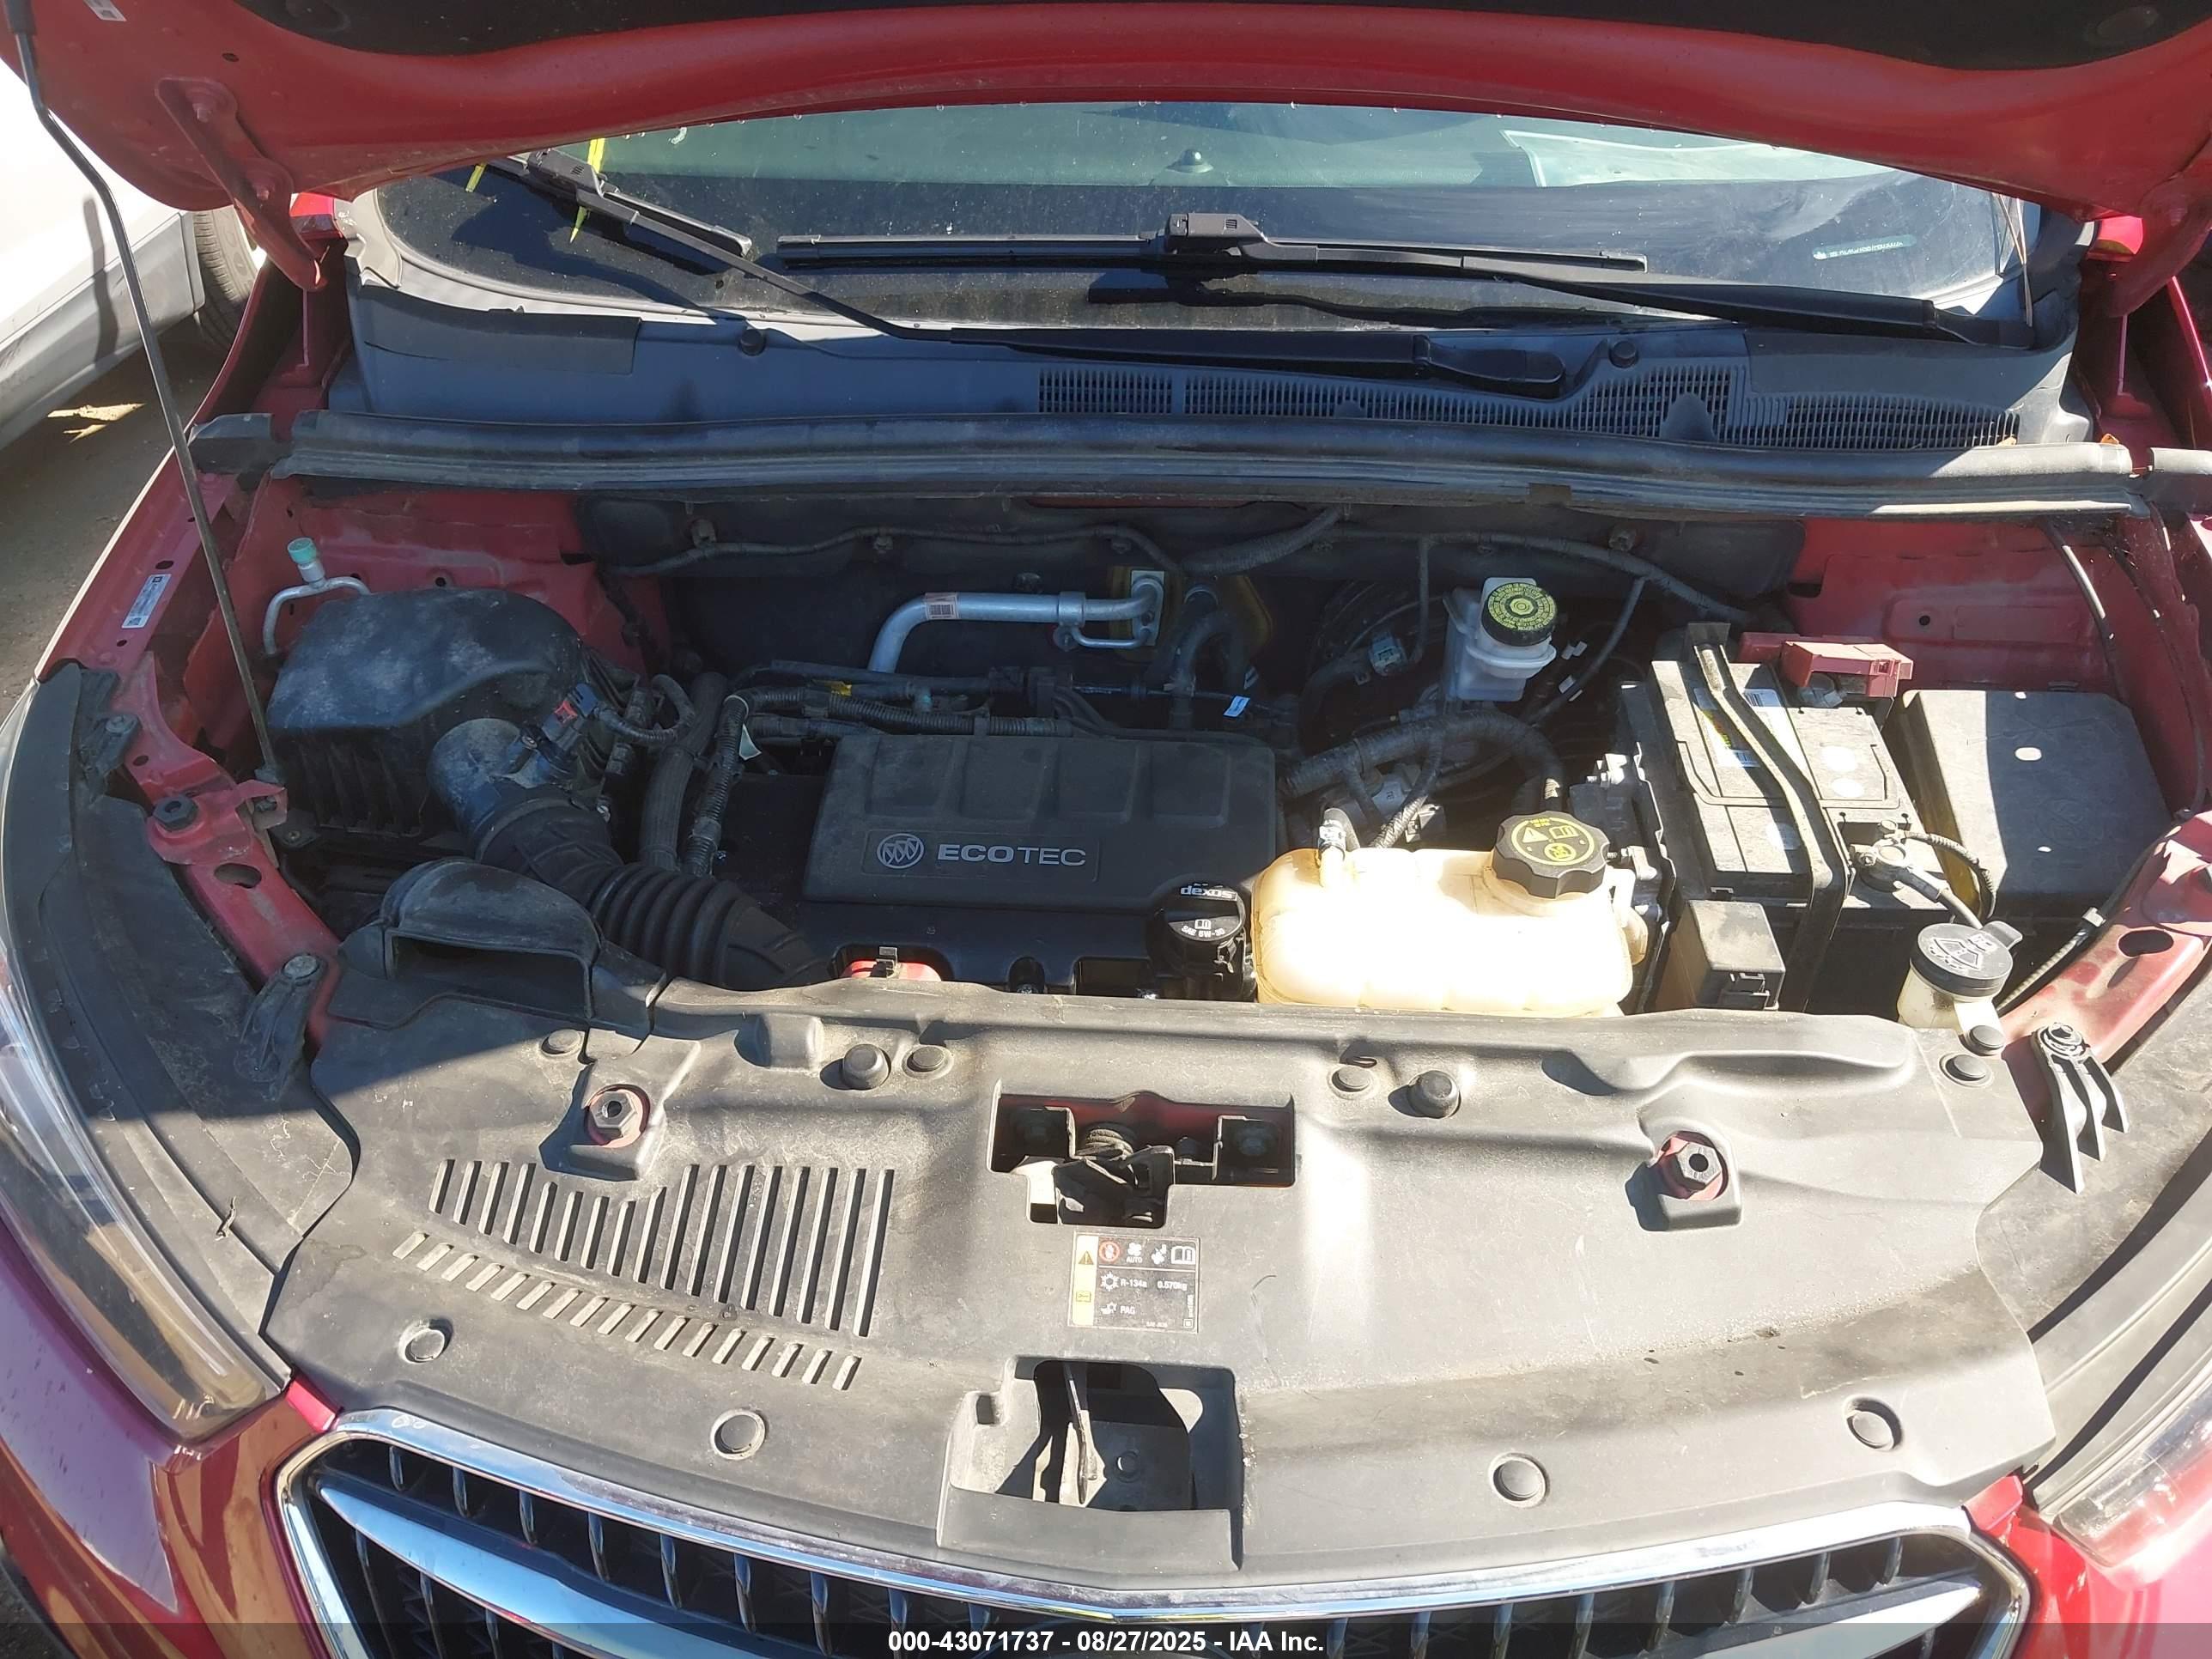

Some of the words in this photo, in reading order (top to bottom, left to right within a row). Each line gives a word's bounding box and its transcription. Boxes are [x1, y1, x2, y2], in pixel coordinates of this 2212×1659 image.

[938, 844, 1086, 866] ECOTEC
[1180, 885, 1233, 899] dexos
[1120, 1279, 1147, 1288] R-134a
[1120, 1305, 1135, 1315] PAG
